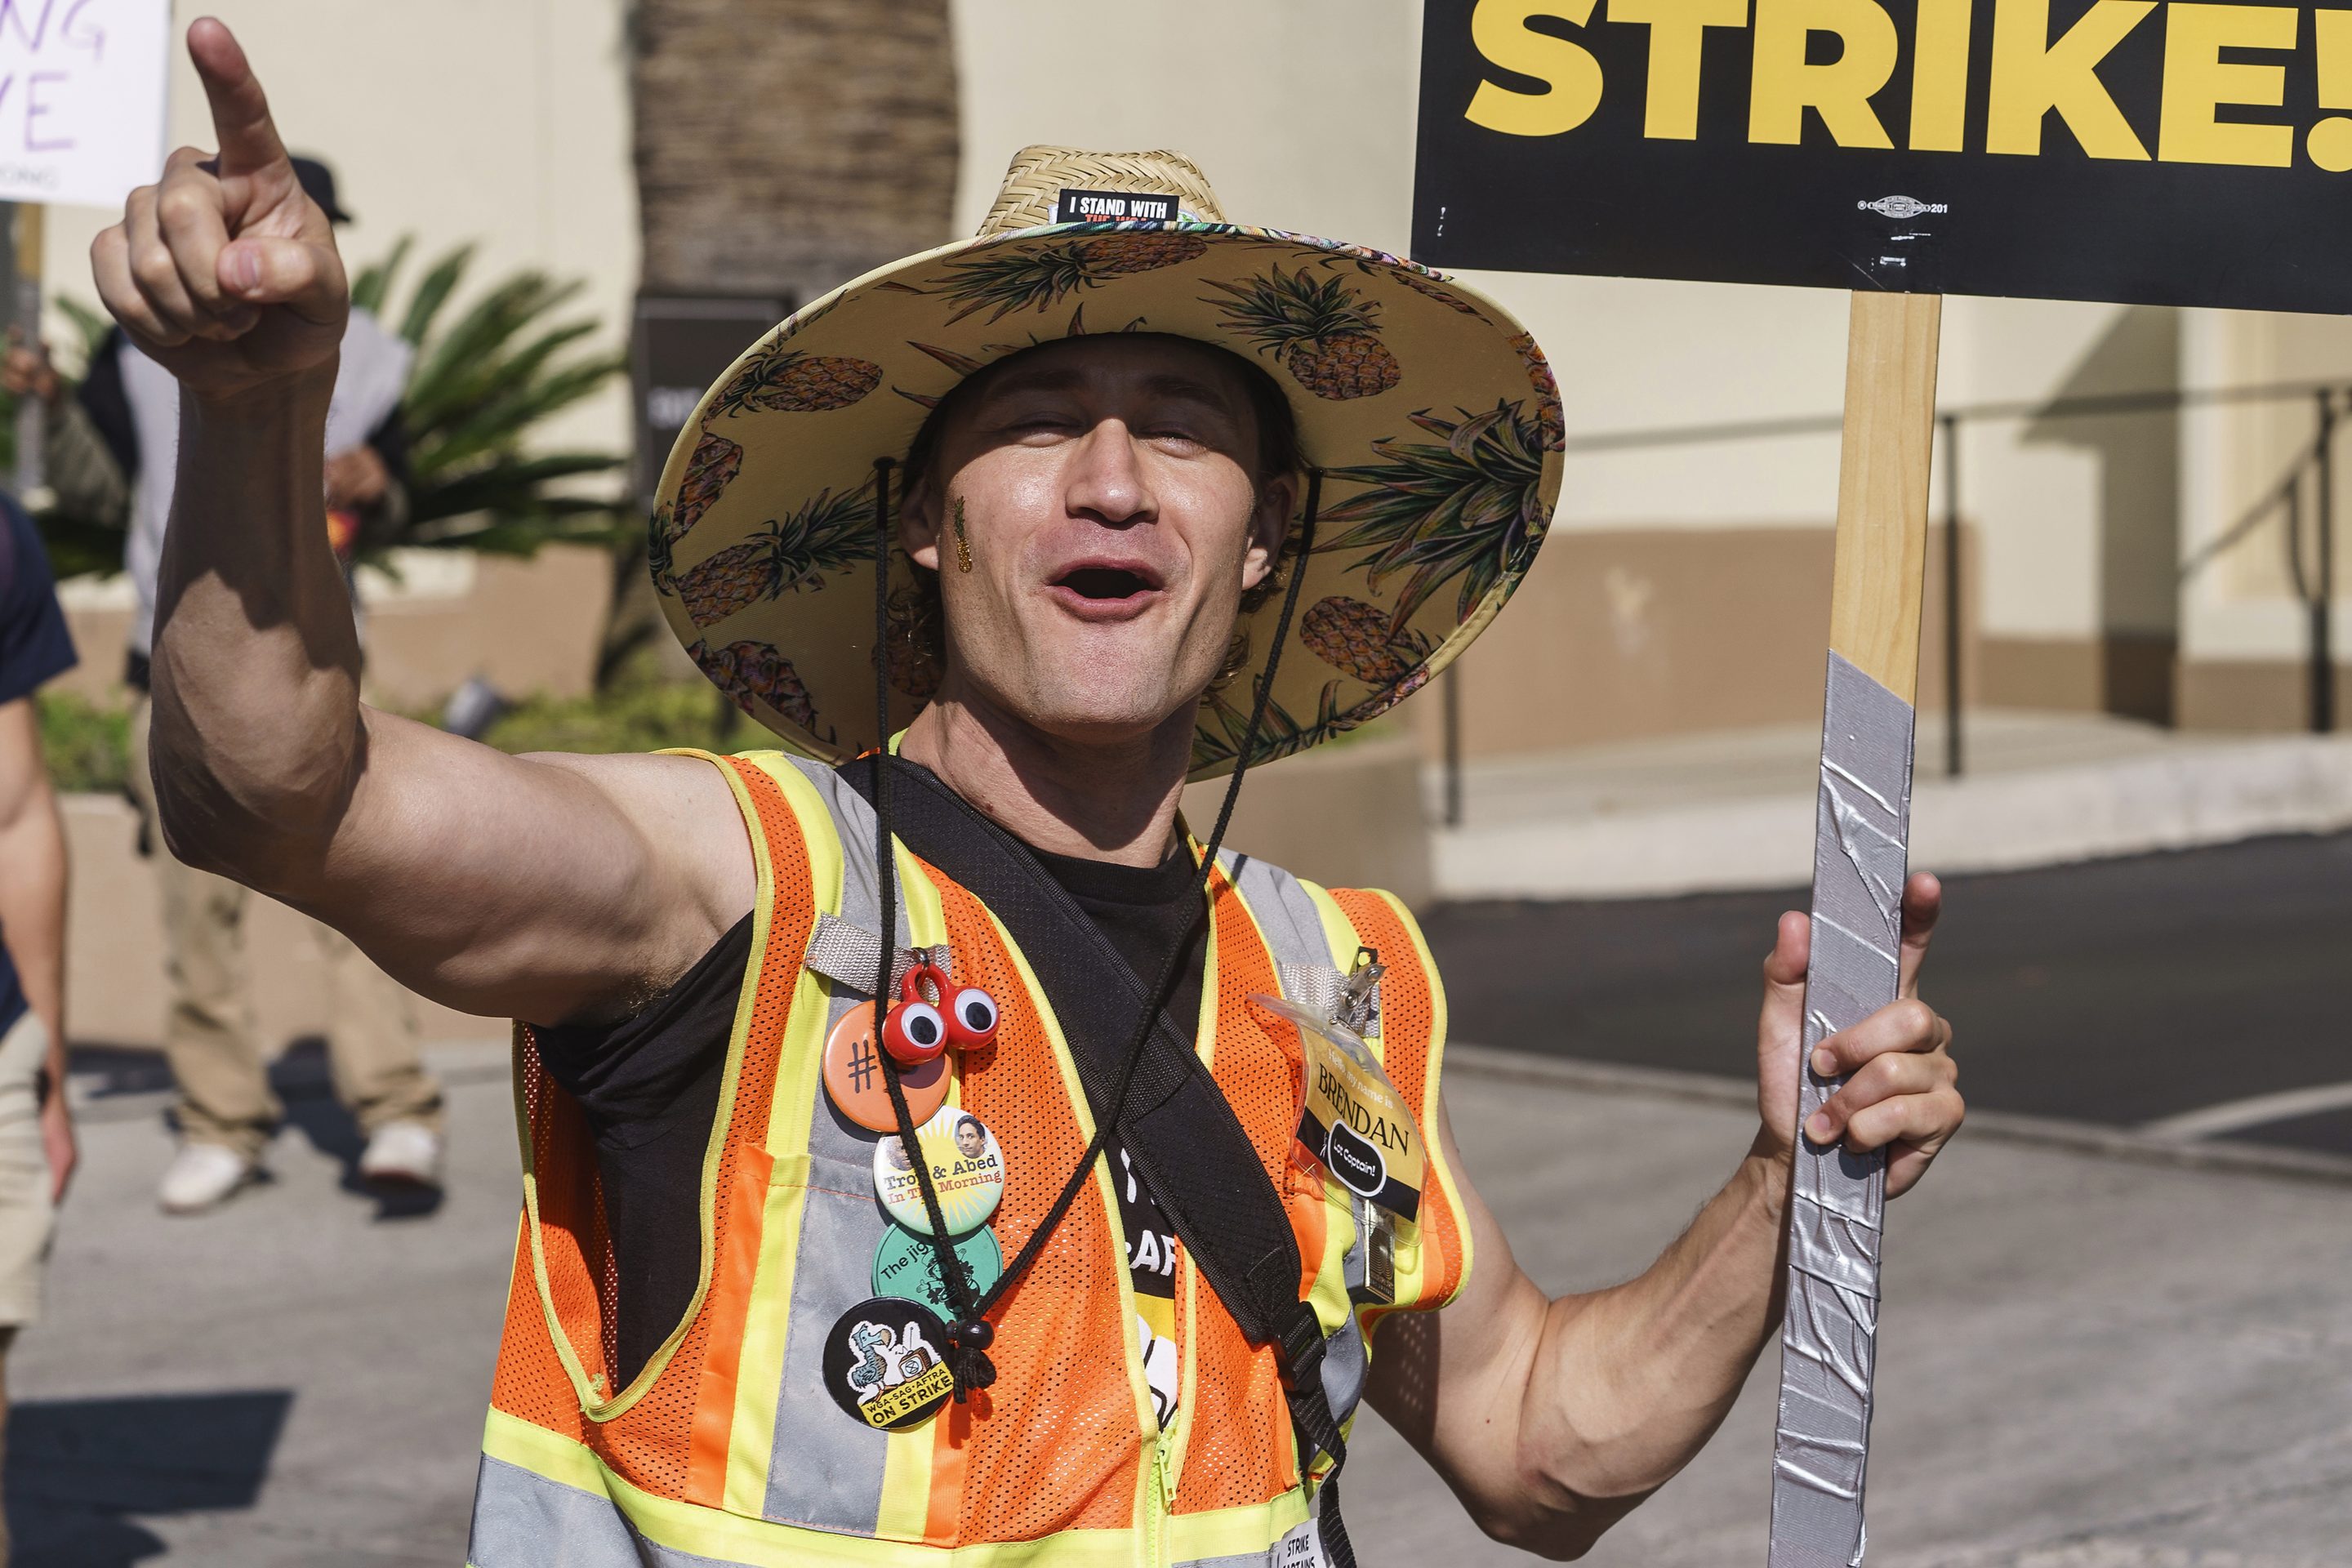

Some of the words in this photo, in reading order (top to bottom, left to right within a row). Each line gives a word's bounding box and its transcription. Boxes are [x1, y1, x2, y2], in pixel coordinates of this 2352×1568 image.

[1463, 0, 2352, 172] STRIKE!
[1069, 196, 1076, 213] I
[1080, 197, 1125, 216] STAND
[1130, 200, 1168, 219] WITH
[1931, 203, 1948, 213] 201
[1318, 1062, 1410, 1156] BRENDAN
[1357, 1081, 1383, 1103] name
[1384, 1095, 1393, 1109] is
[884, 1174, 920, 1190] Tro
[933, 1165, 947, 1179] &
[952, 1154, 998, 1176] Abed
[1343, 1148, 1376, 1177] Captain!
[888, 1192, 906, 1205] In
[938, 1170, 1002, 1193] Morning
[880, 1256, 909, 1280] The
[906, 1242, 929, 1263] jig
[872, 1405, 897, 1424] ON
[899, 1375, 953, 1410] STRIKE
[1286, 1534, 1310, 1558] STRIKE
